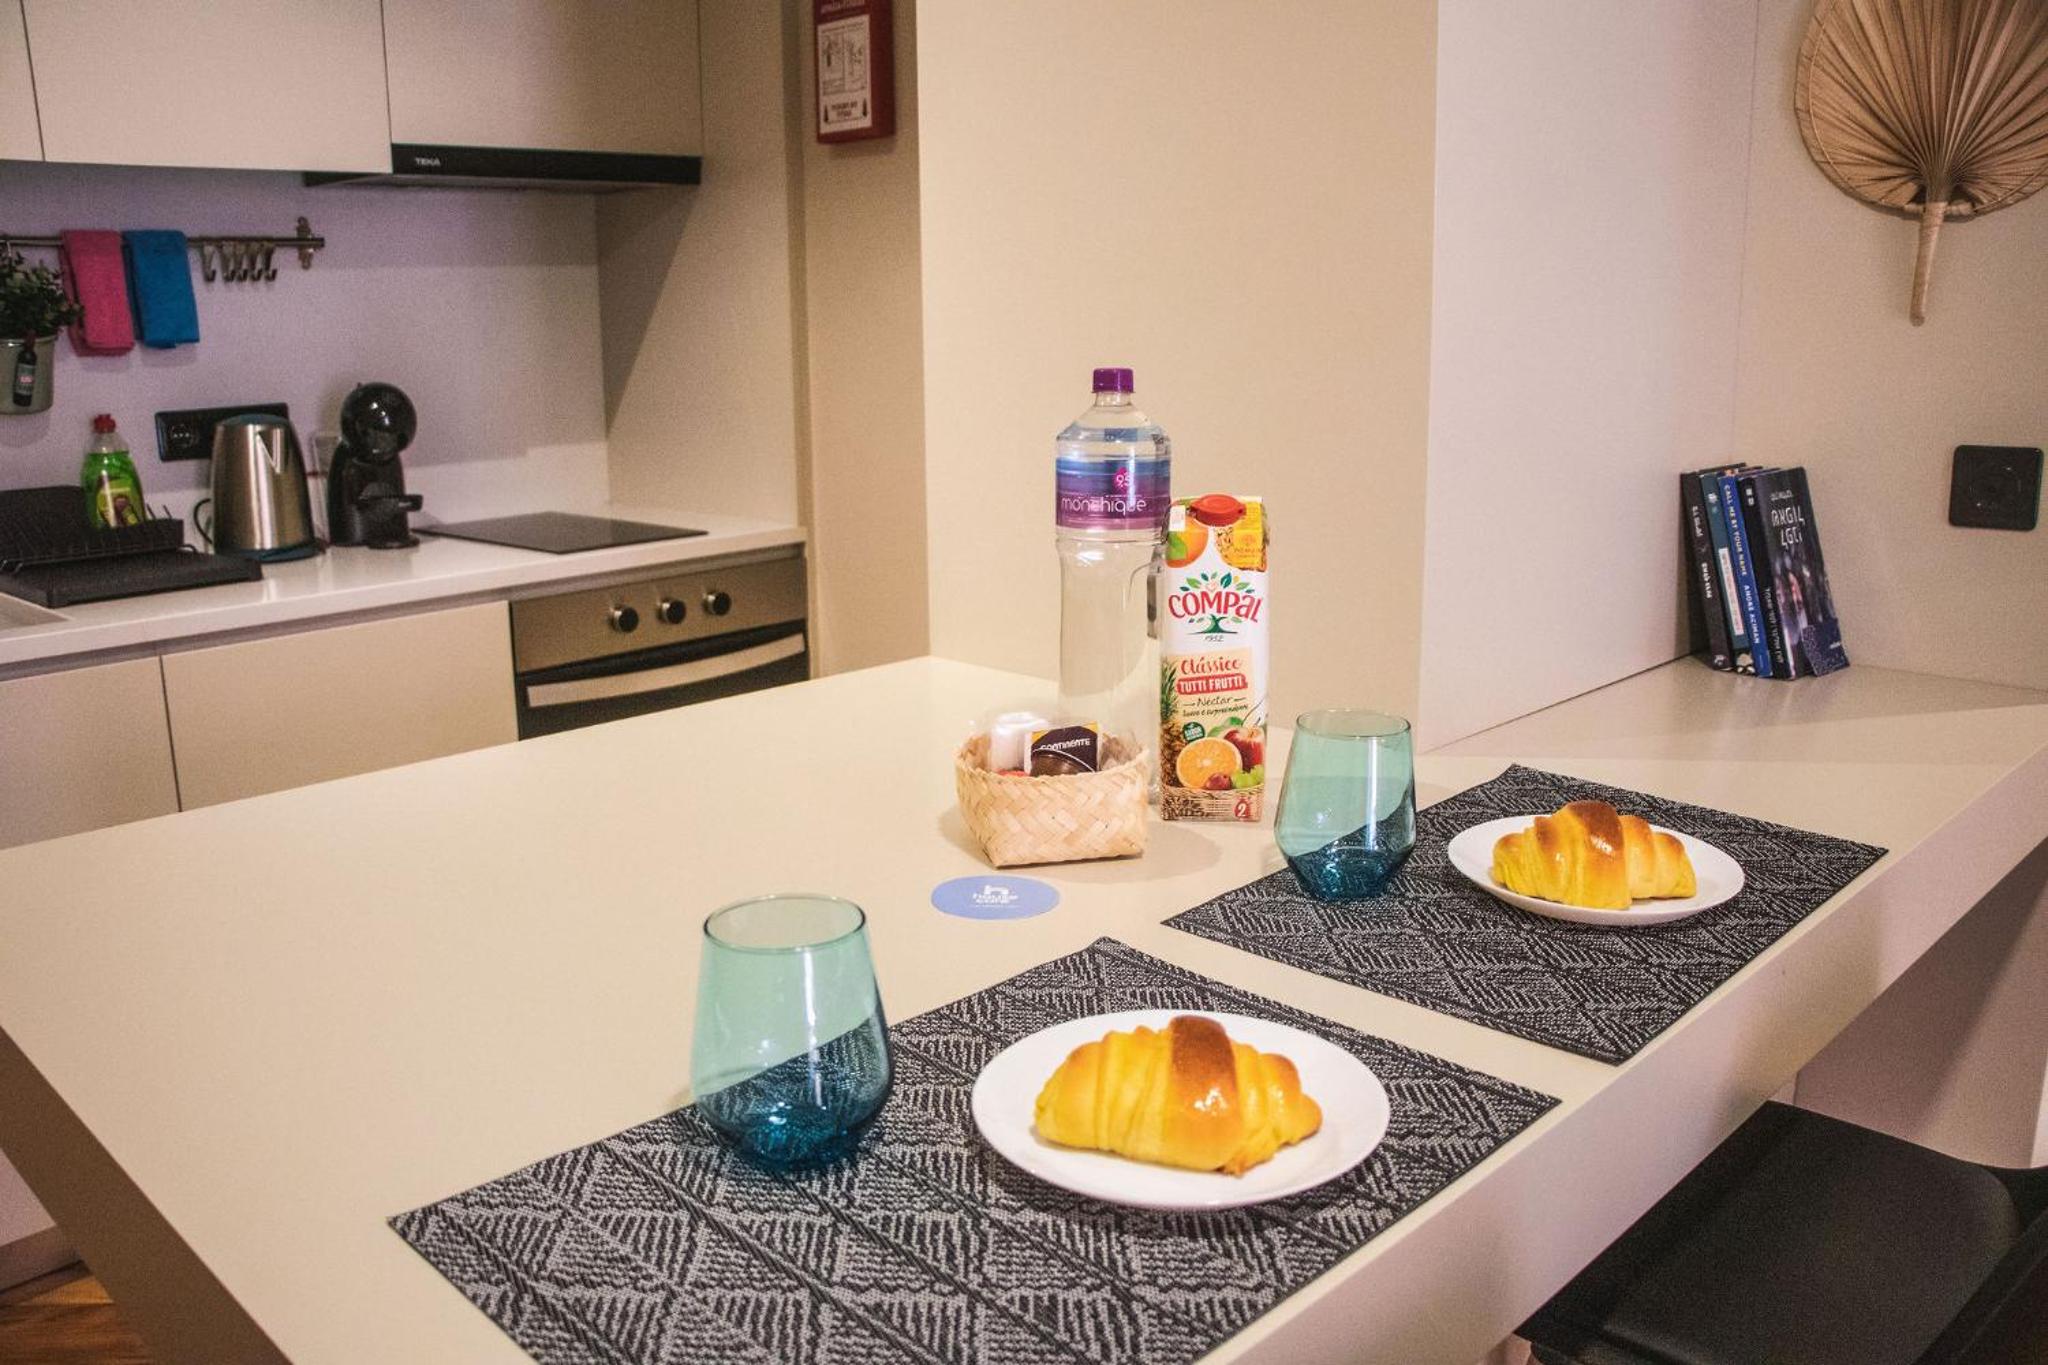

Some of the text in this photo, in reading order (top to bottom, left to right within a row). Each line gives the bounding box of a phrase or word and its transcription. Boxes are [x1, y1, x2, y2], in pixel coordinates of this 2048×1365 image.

[415, 157, 441, 167] TEKA
[1061, 496, 1147, 516] monhique
[1180, 676, 1242, 692] TUTTI FRUTTI
[1237, 802, 1248, 817] 2
